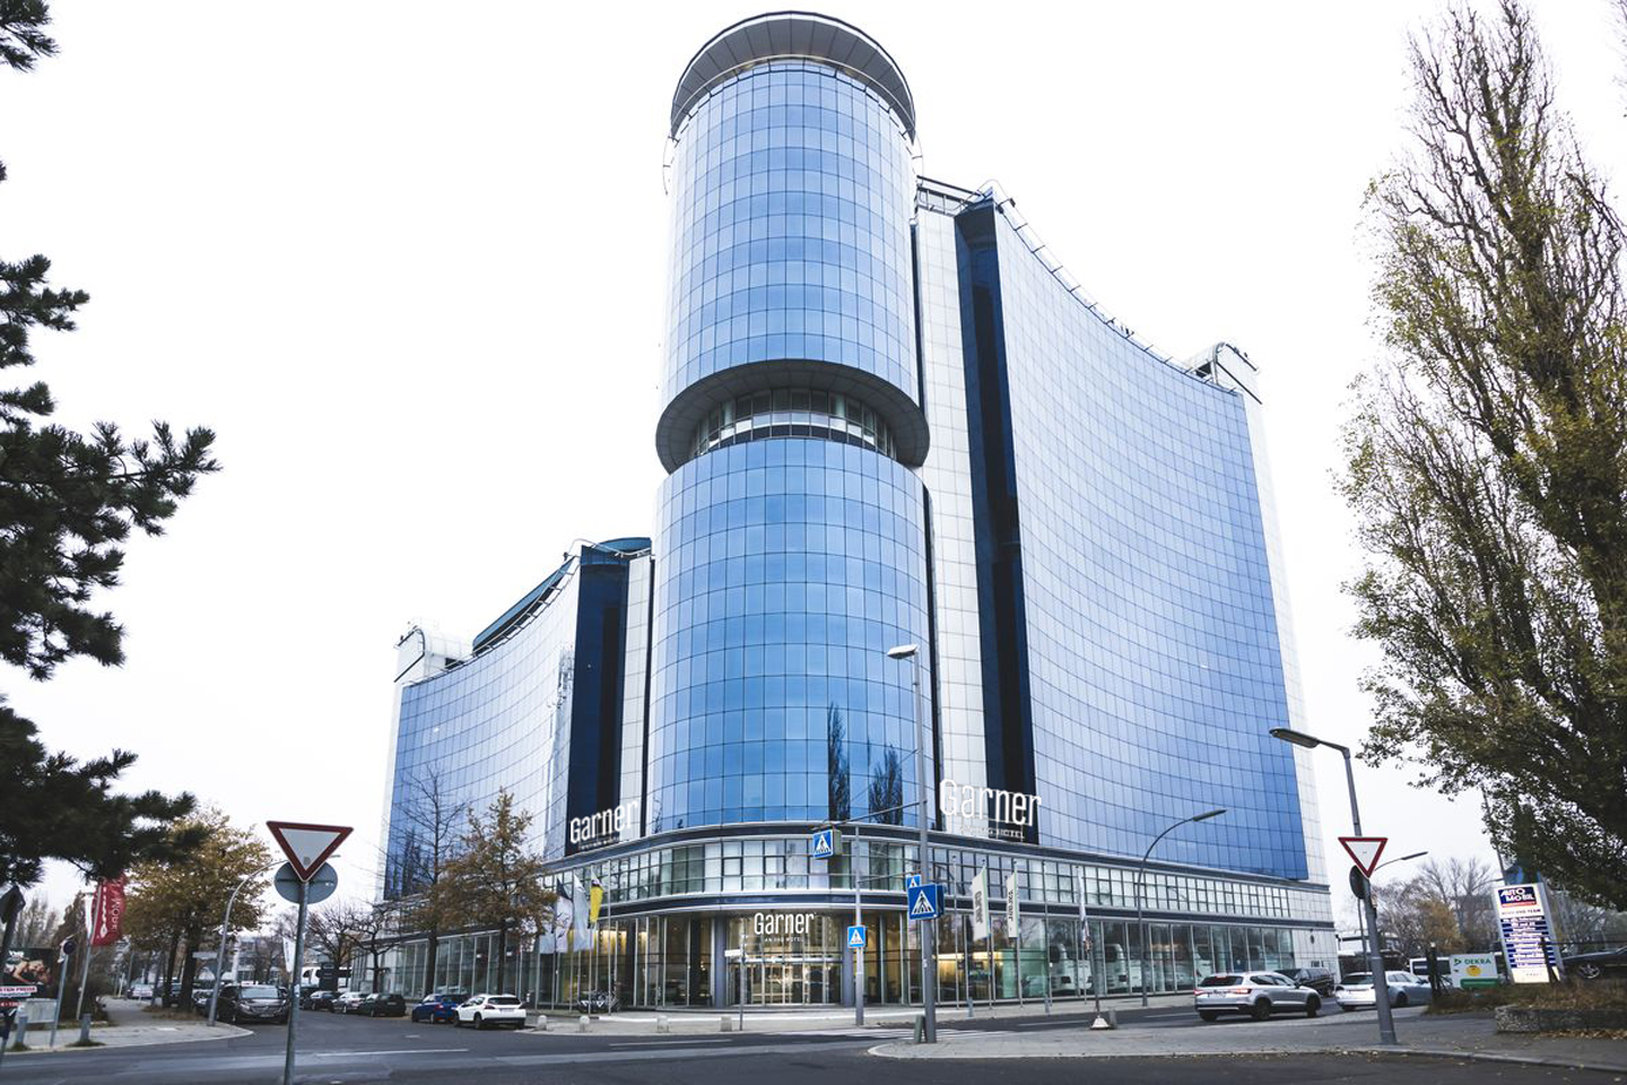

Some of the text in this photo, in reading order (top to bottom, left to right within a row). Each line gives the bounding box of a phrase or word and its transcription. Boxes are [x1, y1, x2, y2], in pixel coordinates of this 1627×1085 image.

[940, 779, 1042, 826] Garner
[570, 801, 638, 844] Garner
[1500, 887, 1526, 897] AUTO
[1505, 893, 1535, 902] MOBIL
[754, 912, 814, 935] Garner
